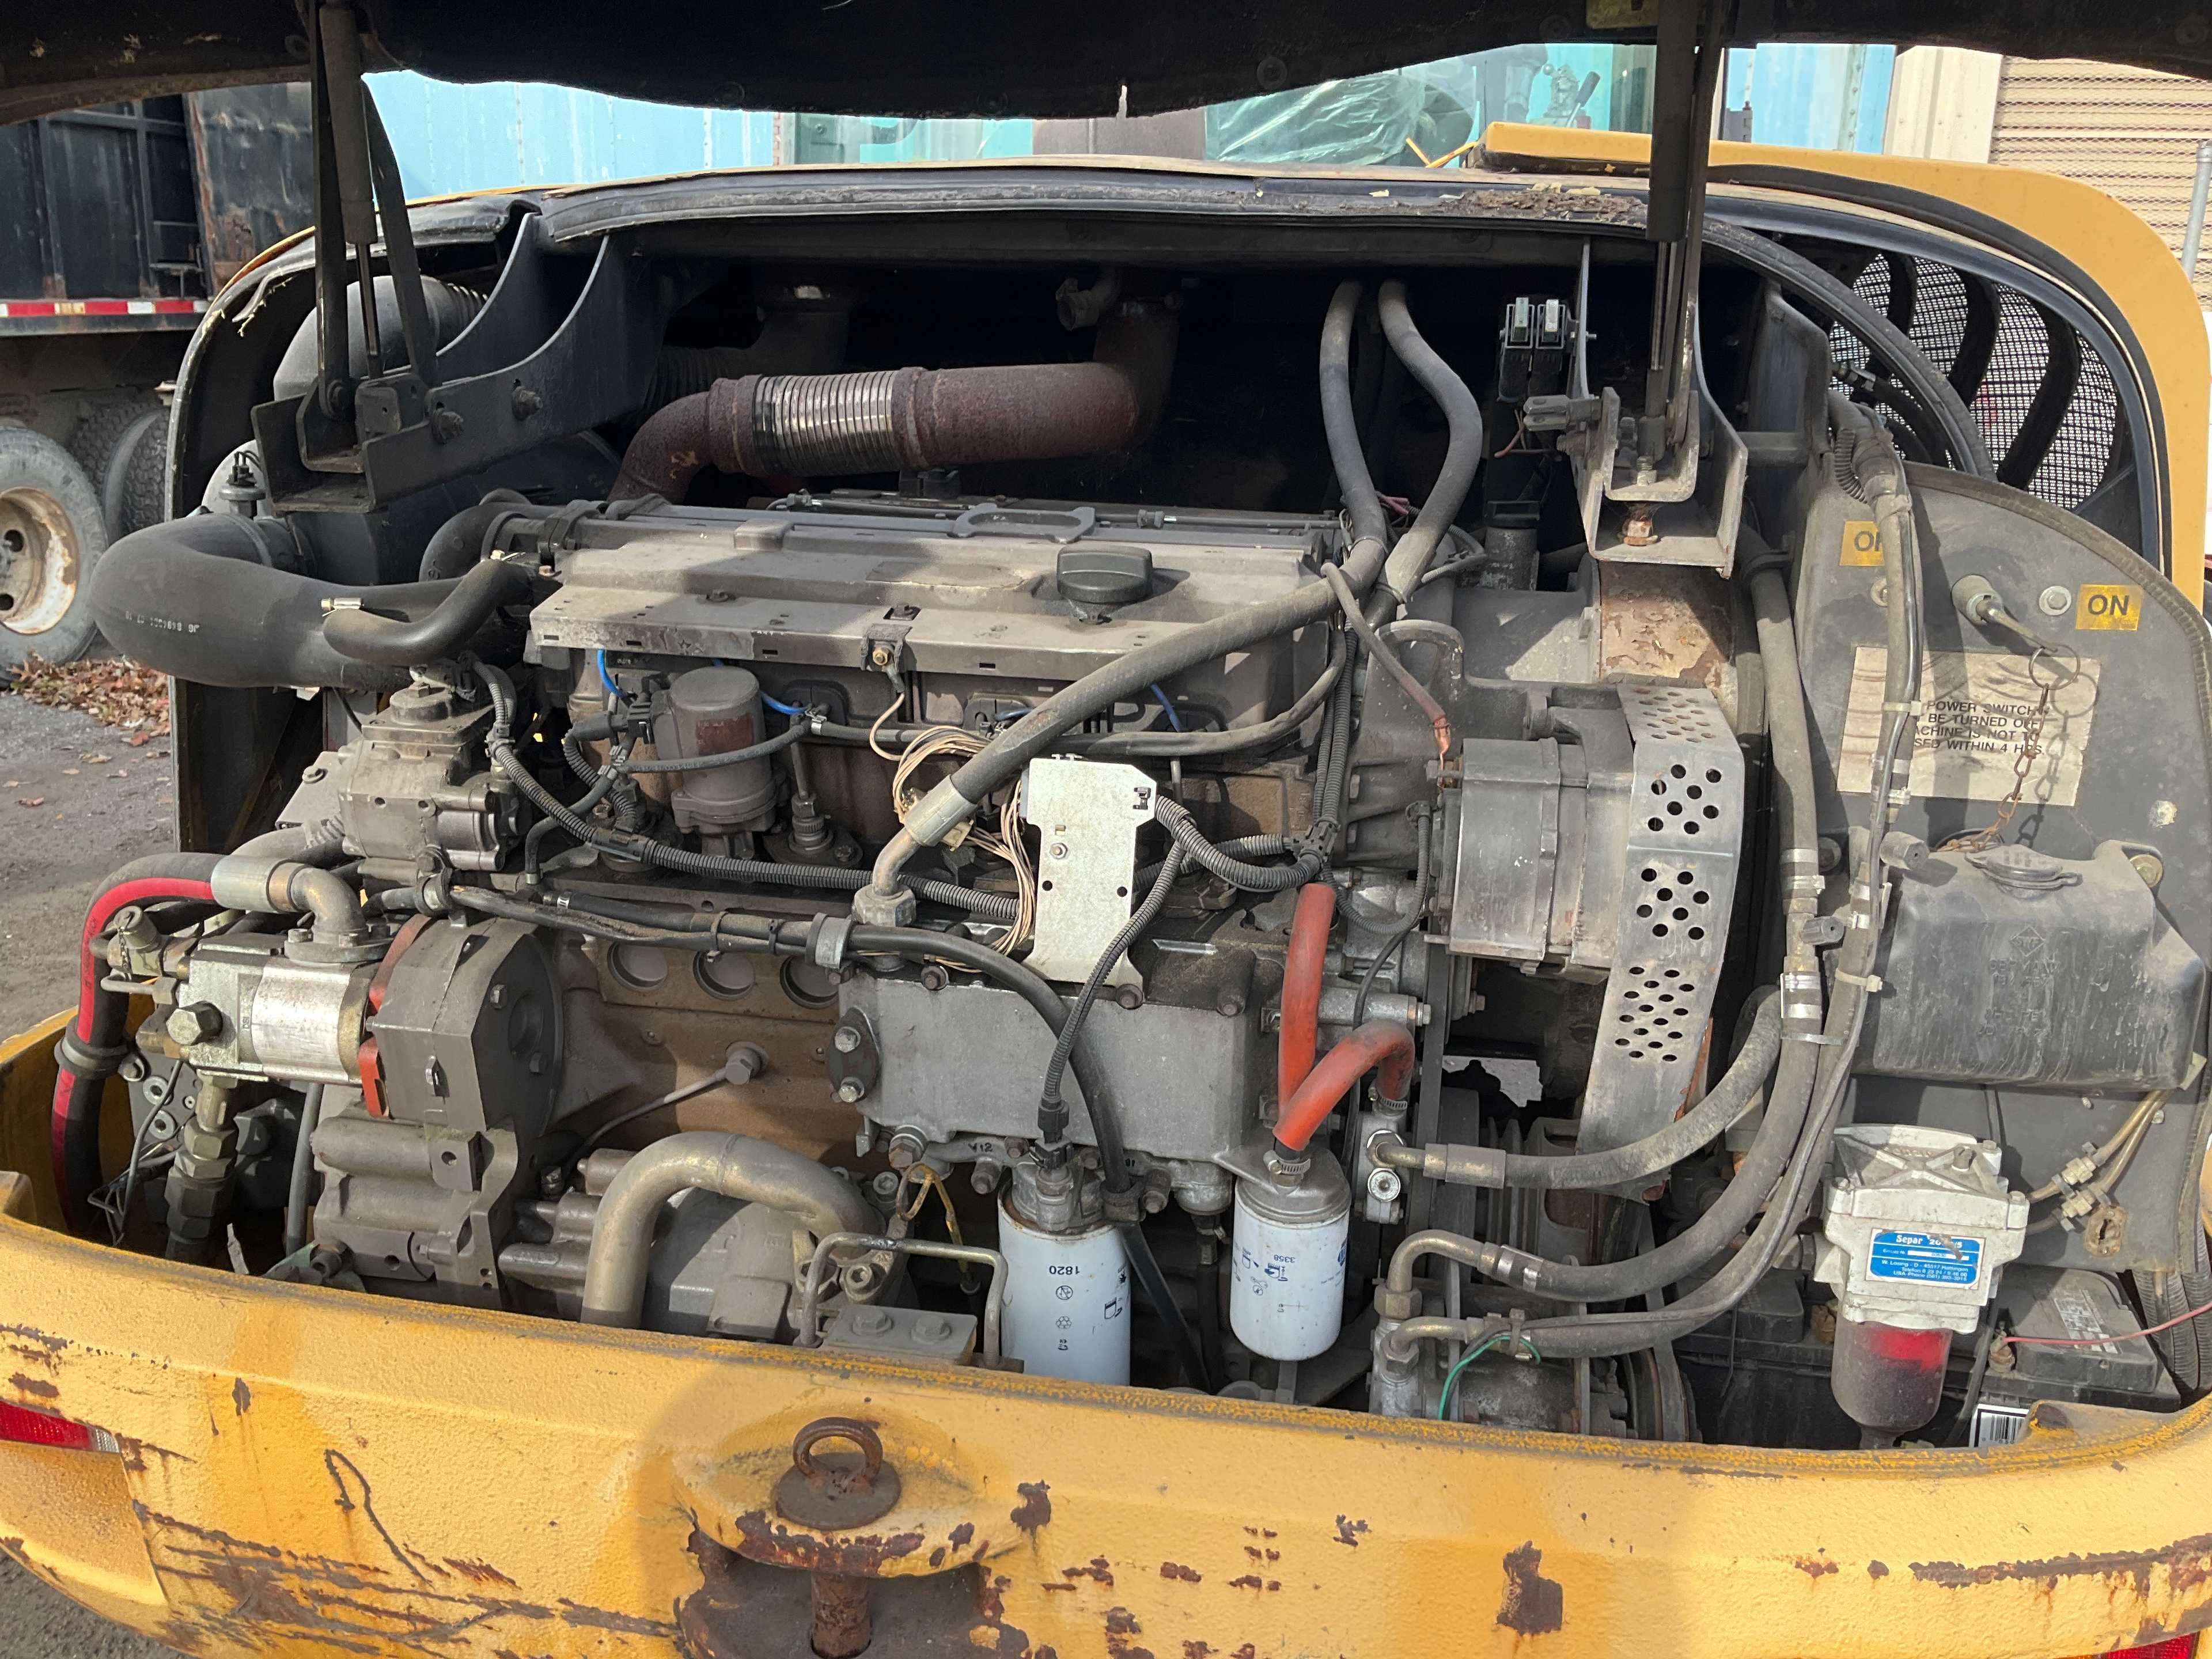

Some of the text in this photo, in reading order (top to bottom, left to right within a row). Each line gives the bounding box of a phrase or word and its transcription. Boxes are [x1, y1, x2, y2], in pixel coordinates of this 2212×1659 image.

[2088, 594, 2129, 615] ON
[1927, 700, 2038, 716] POWER SWITCH
[1929, 713, 1946, 724] BE
[1952, 714, 2008, 727] TURNED
[1968, 729, 1981, 738] IS
[1988, 730, 2017, 741] NOT
[1947, 740, 1994, 751] WITHIN
[1999, 744, 2008, 753] 4
[1896, 1234, 1963, 1249] Separ 20/5
[1274, 1254, 1296, 1263] 3358
[1049, 1266, 1080, 1275] 1820
